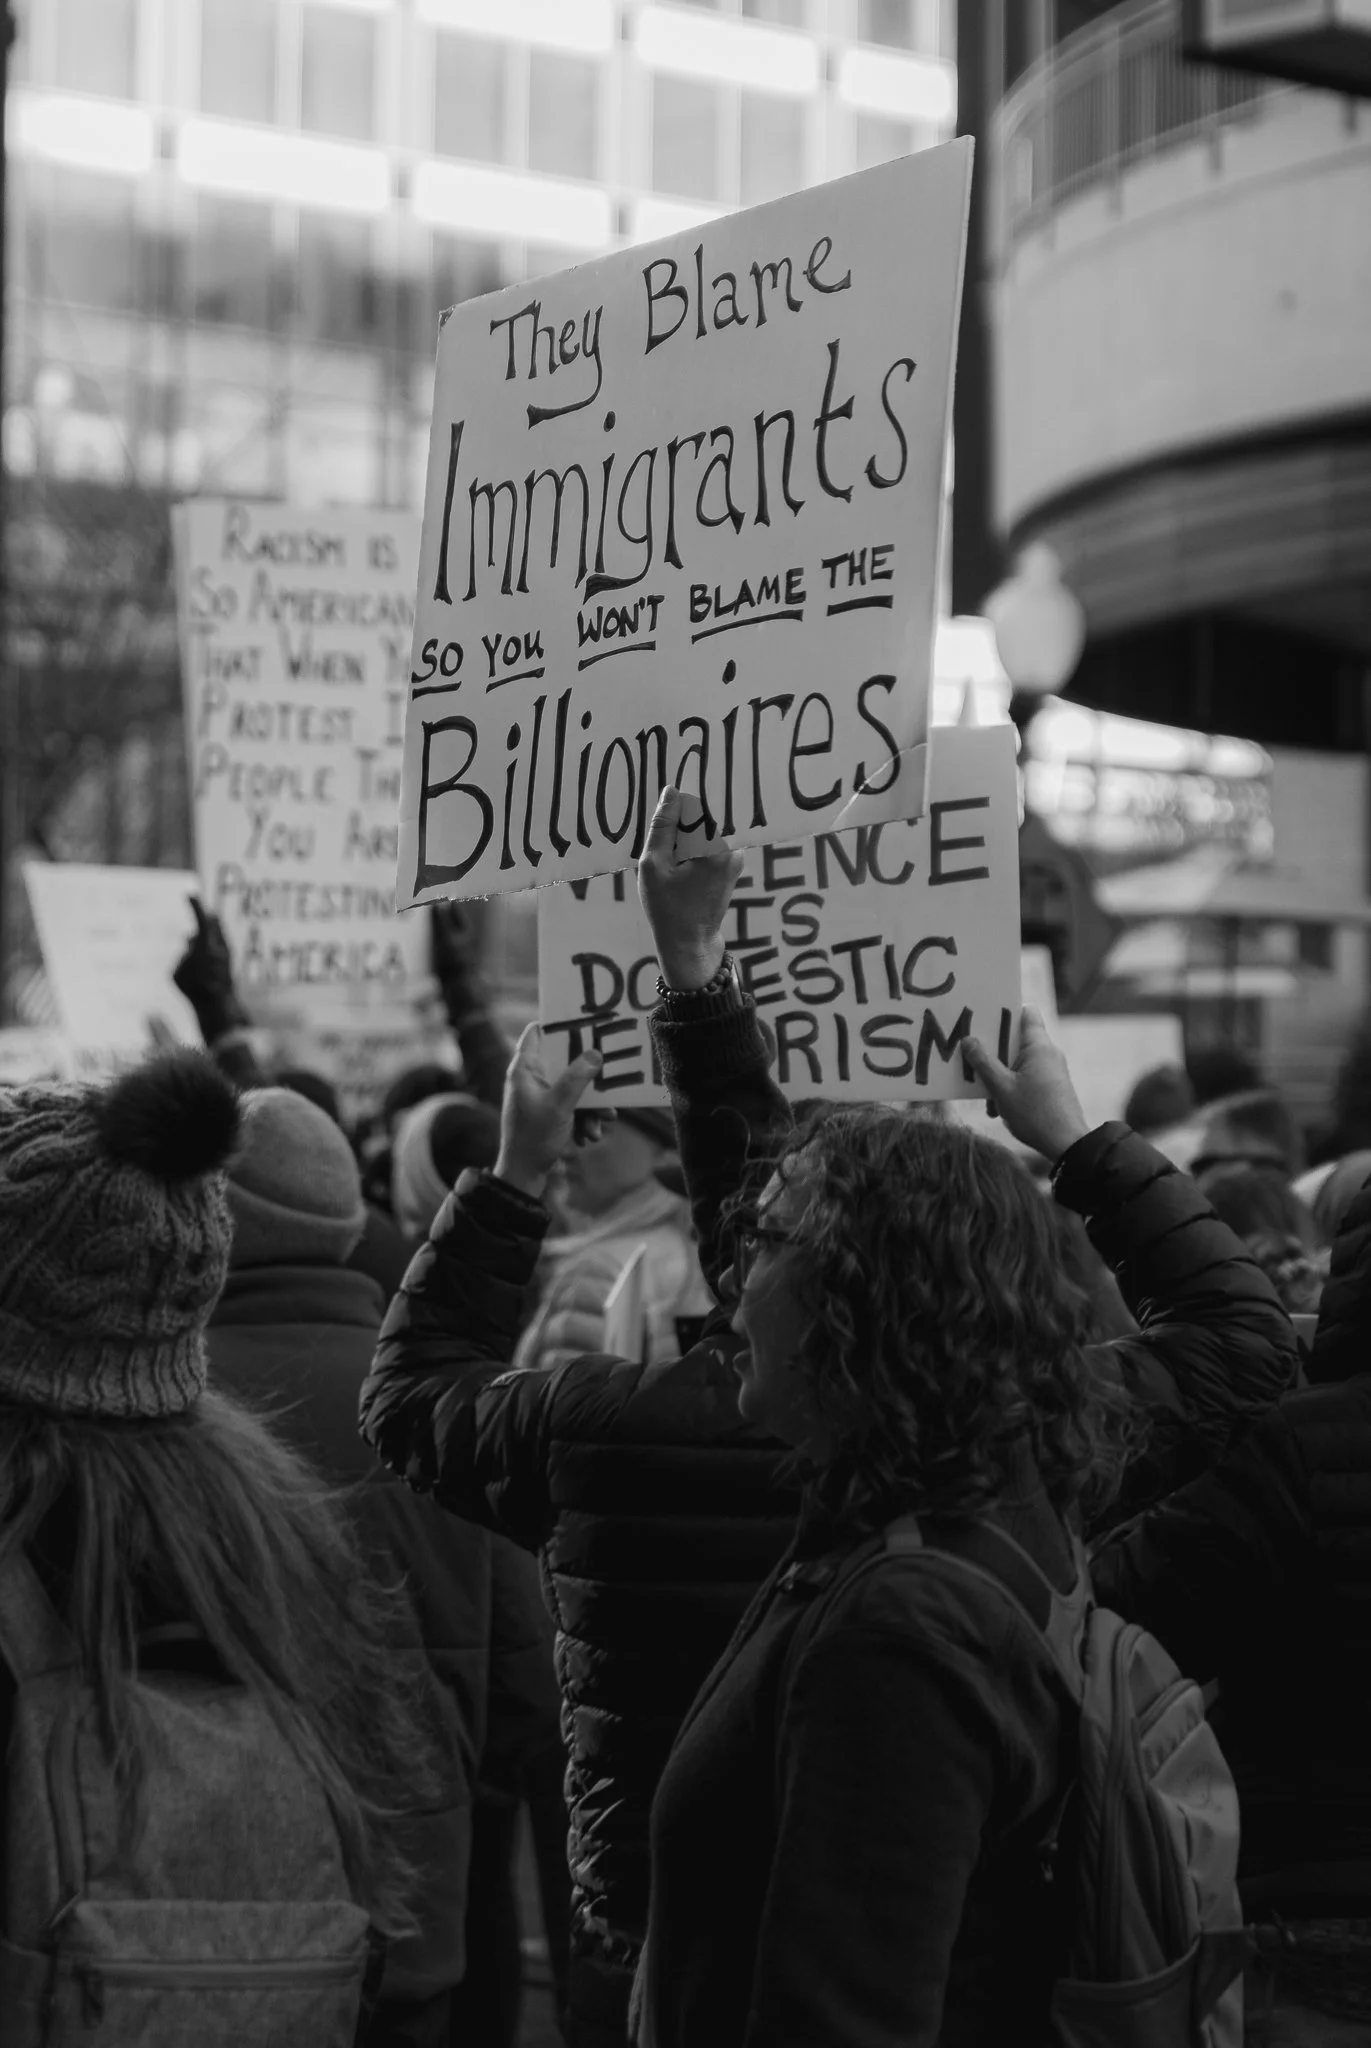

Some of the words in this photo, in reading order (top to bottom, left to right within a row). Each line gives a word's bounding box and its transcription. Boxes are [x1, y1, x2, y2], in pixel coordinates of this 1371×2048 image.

[490, 300, 603, 429] They
[642, 236, 851, 354] Blame
[434, 338, 917, 604] Immigrants
[411, 638, 464, 683] SO
[482, 629, 545, 678] YOU
[577, 594, 665, 647] WON'T
[690, 567, 807, 623] BLAME
[821, 543, 895, 588] THE
[244, 806, 317, 863] YOU
[413, 660, 902, 898] Billionaires
[571, 934, 959, 1013] DOESTIC
[723, 892, 836, 951] IS
